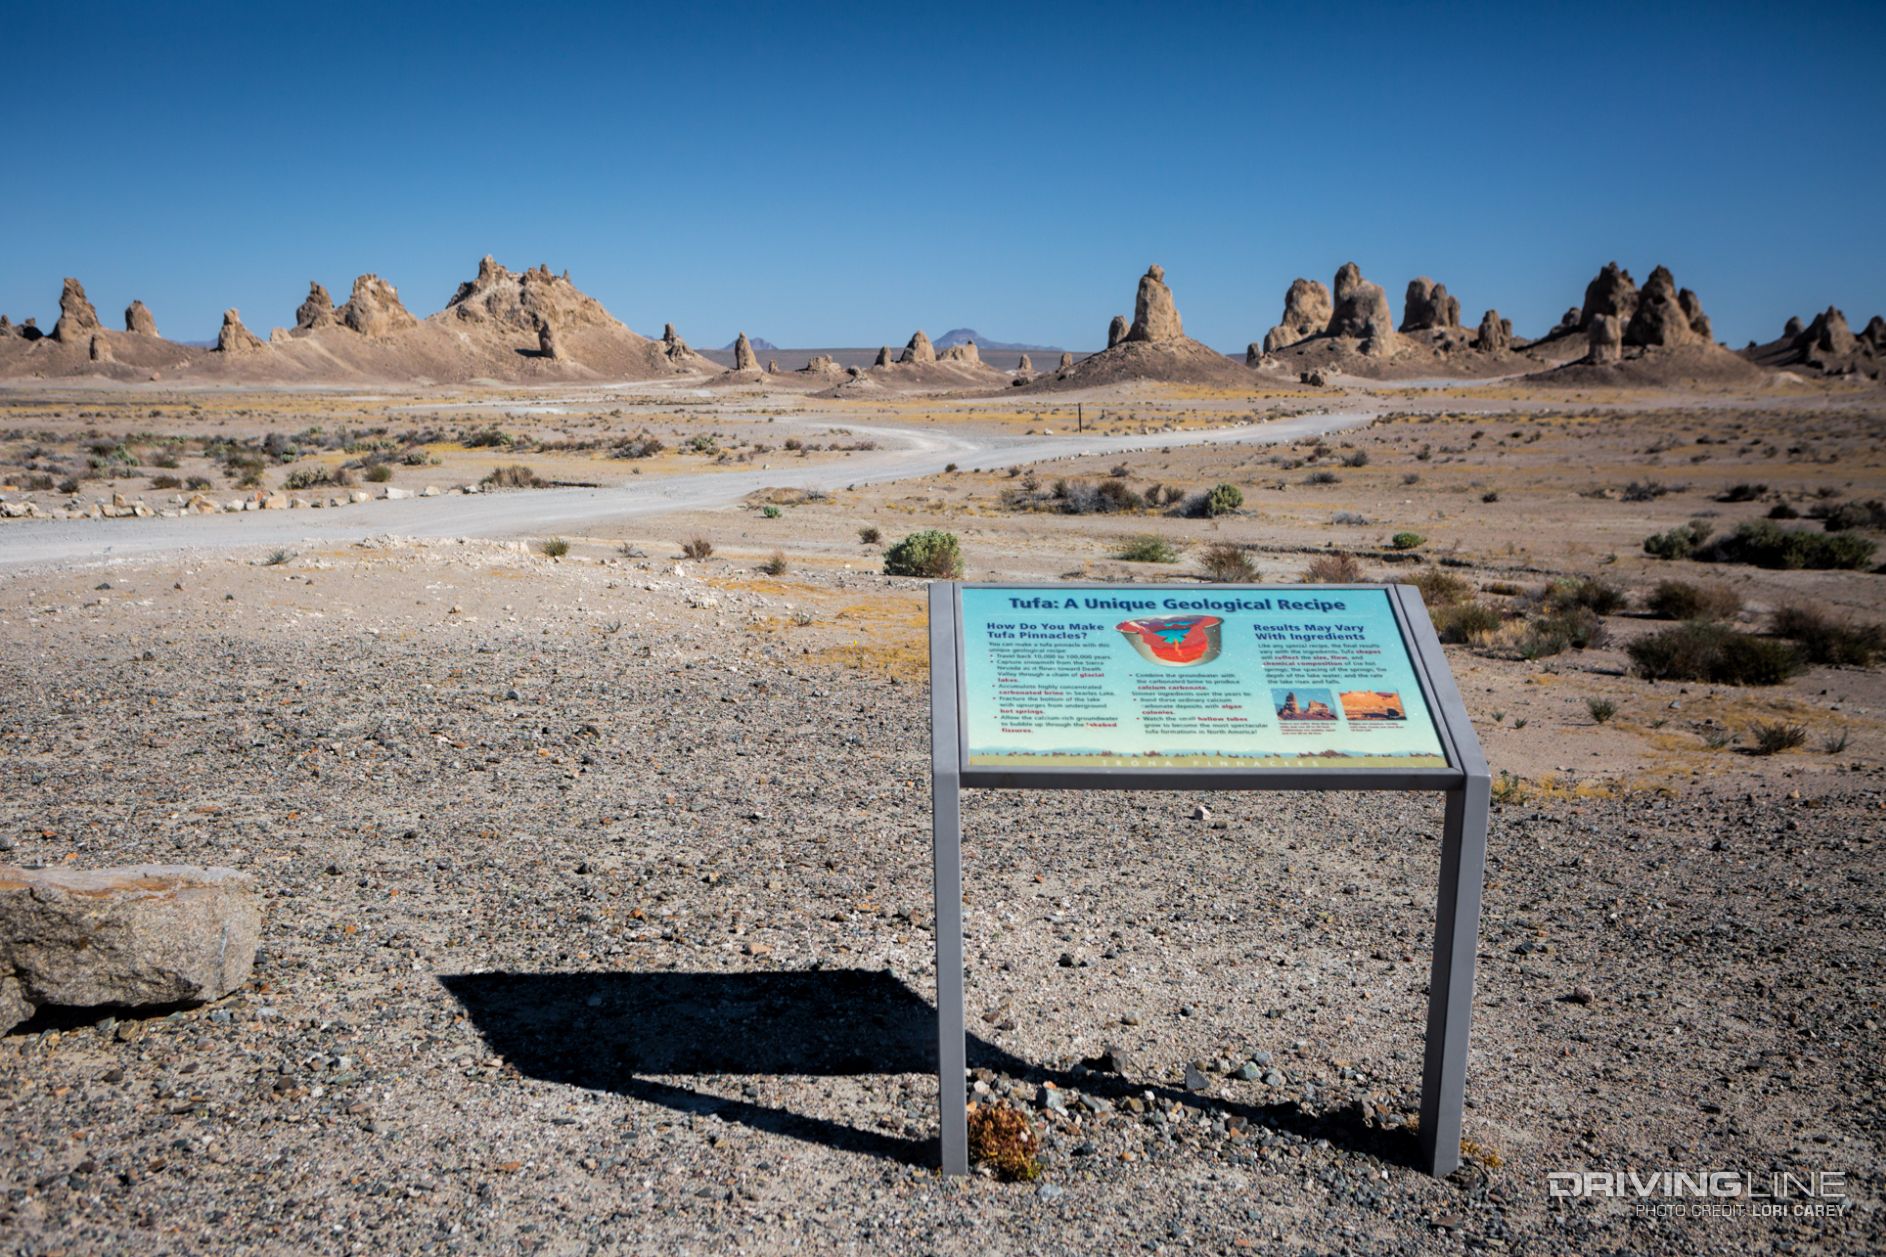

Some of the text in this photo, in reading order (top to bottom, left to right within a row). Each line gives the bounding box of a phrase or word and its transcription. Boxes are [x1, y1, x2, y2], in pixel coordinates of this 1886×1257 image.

[1009, 597, 1346, 612] Tufa: A Unique Geological Recipe
[1304, 624, 1331, 632] May
[1335, 624, 1364, 632] Vary
[1290, 633, 1365, 642] Ingredients
